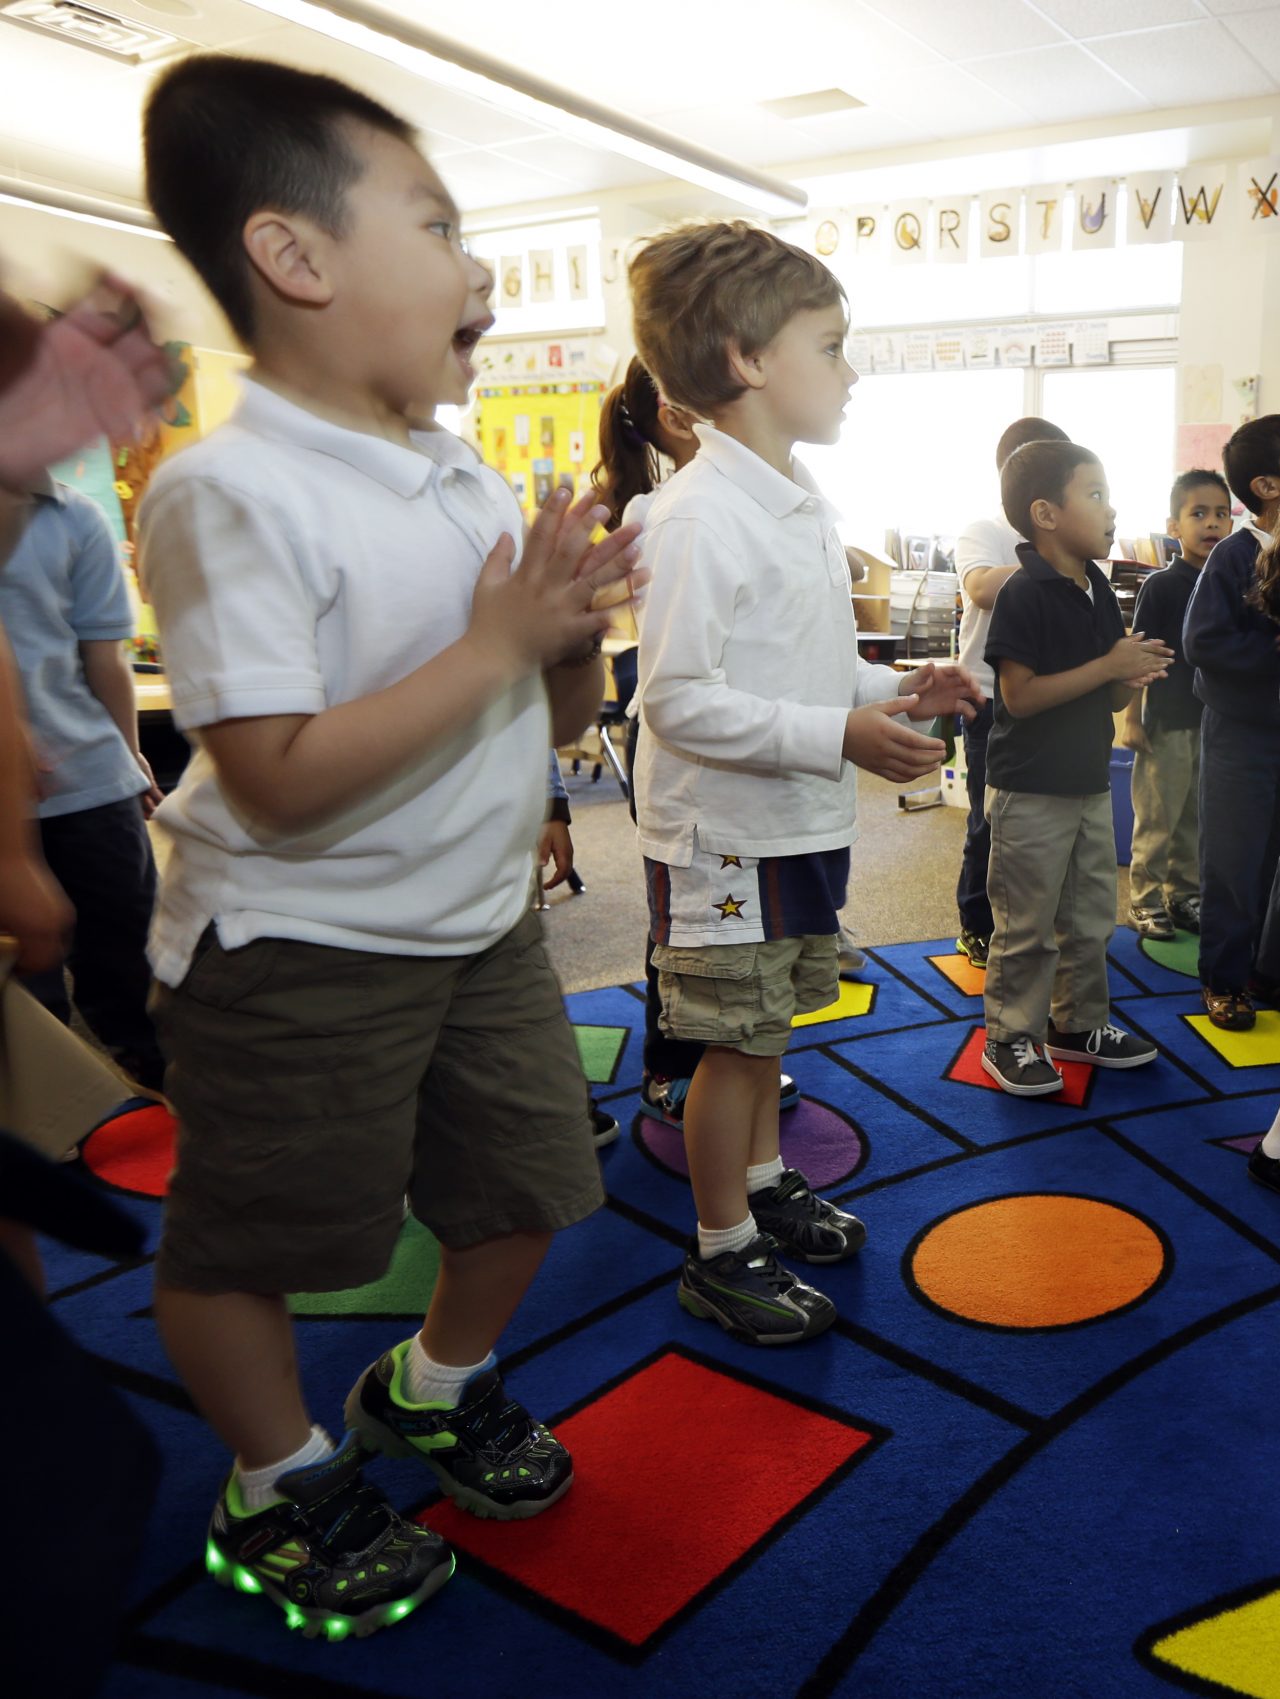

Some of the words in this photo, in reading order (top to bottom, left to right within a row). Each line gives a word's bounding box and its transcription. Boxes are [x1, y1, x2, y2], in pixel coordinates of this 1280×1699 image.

[814, 219, 840, 256] O
[856, 216, 876, 238] P
[894, 212, 922, 251] Q
[939, 210, 962, 249] R
[987, 203, 1012, 243] S
[1036, 199, 1057, 240] T
[1080, 192, 1107, 234] U
[1134, 187, 1162, 230] V
[1178, 184, 1224, 225] W
[1249, 172, 1279, 220] X
[535, 261, 552, 292] H
